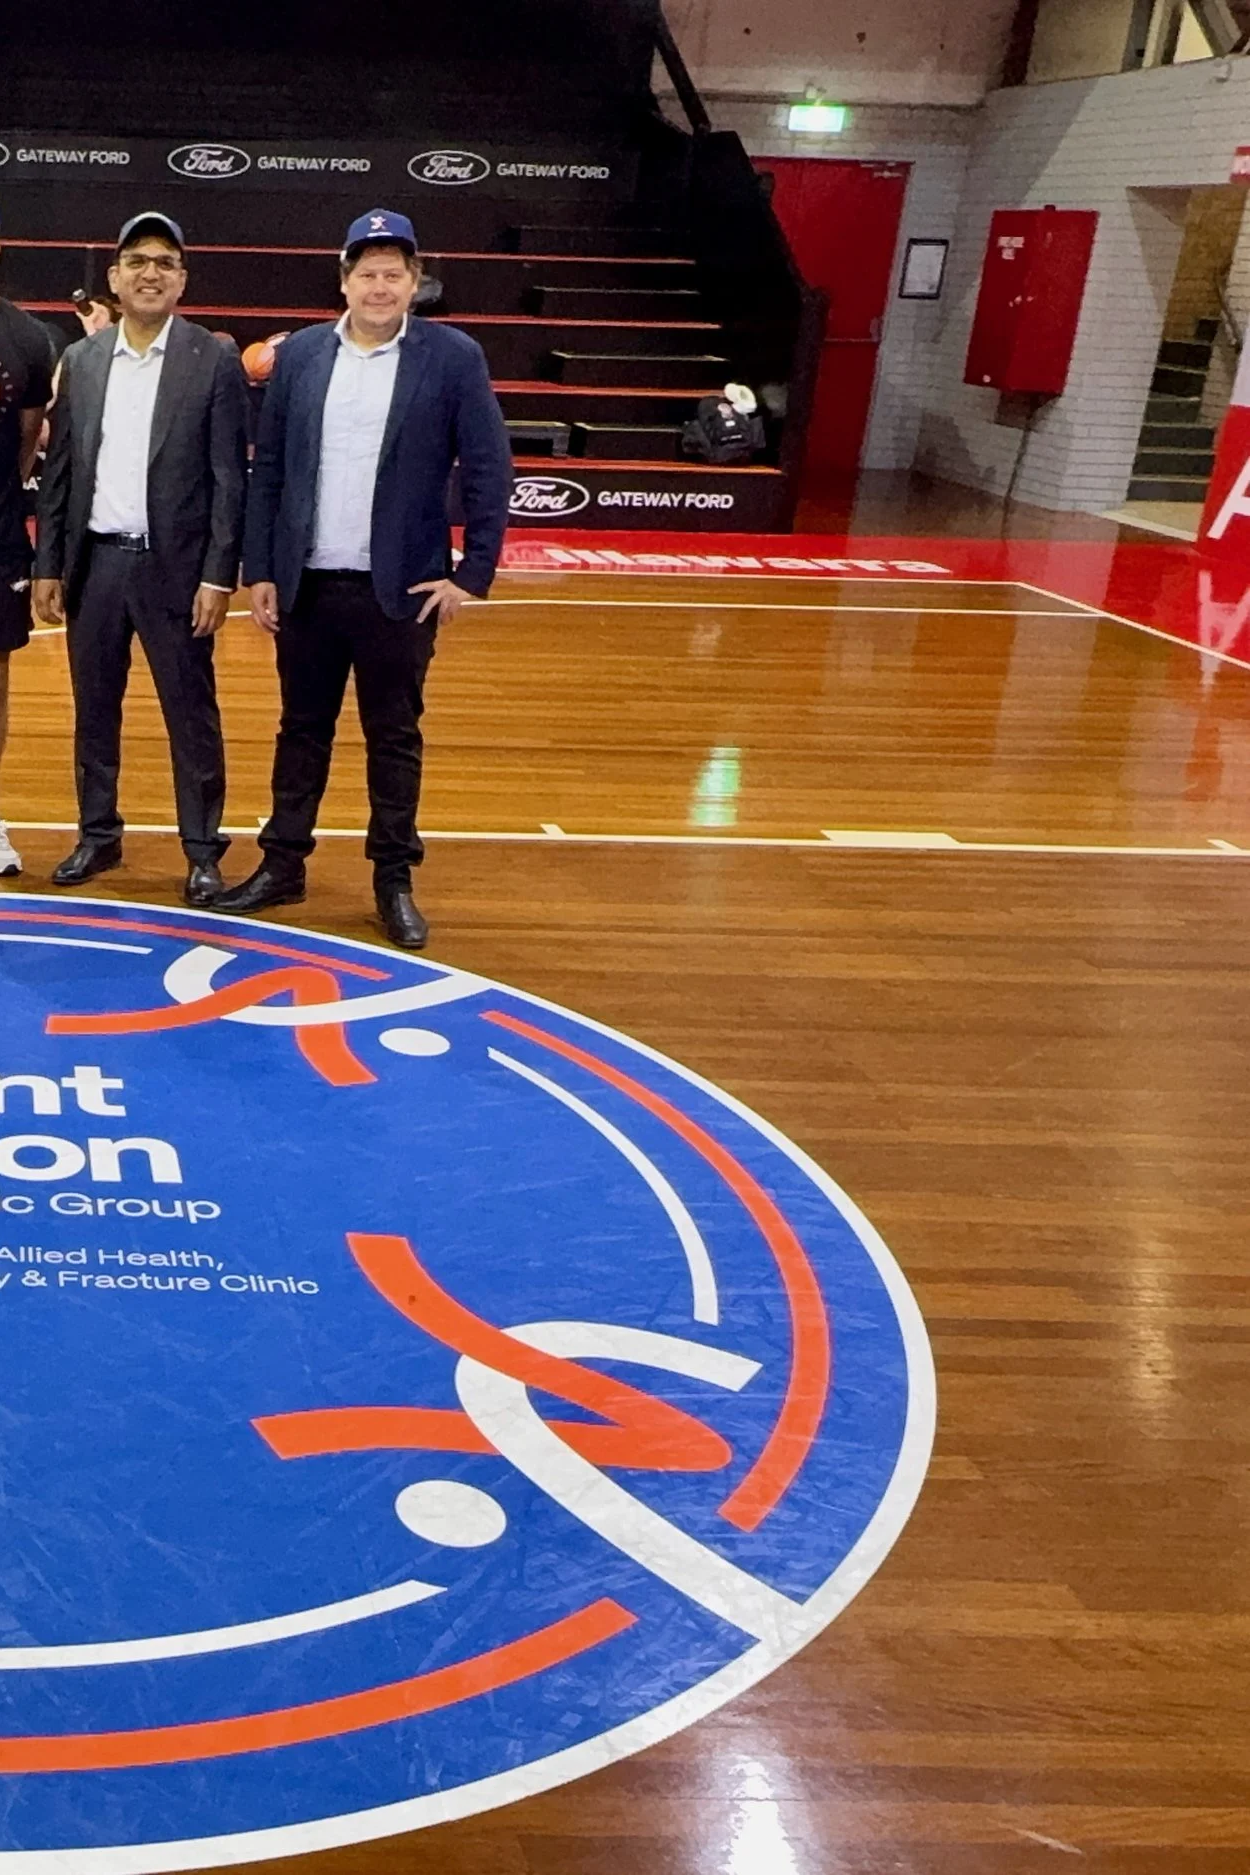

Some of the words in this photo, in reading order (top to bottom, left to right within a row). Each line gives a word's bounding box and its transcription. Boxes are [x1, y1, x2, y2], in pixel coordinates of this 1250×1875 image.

[16, 148, 86, 164] GATEWAY
[89, 150, 130, 165] FORD
[183, 148, 233, 173] Ford
[257, 156, 328, 171] GATEWAY
[330, 157, 371, 172] FORD
[423, 154, 473, 180] Ford
[496, 162, 566, 178] GATEWAY
[569, 164, 610, 179] FORD
[508, 478, 571, 510] Ford
[597, 490, 682, 508] GATEWAY
[684, 493, 734, 510] FORD
[49, 1191, 222, 1224] Group
[97, 1248, 225, 1271] Health,
[20, 1269, 49, 1288] &
[57, 1270, 211, 1292] Fracture
[219, 1273, 320, 1296] Clinic
